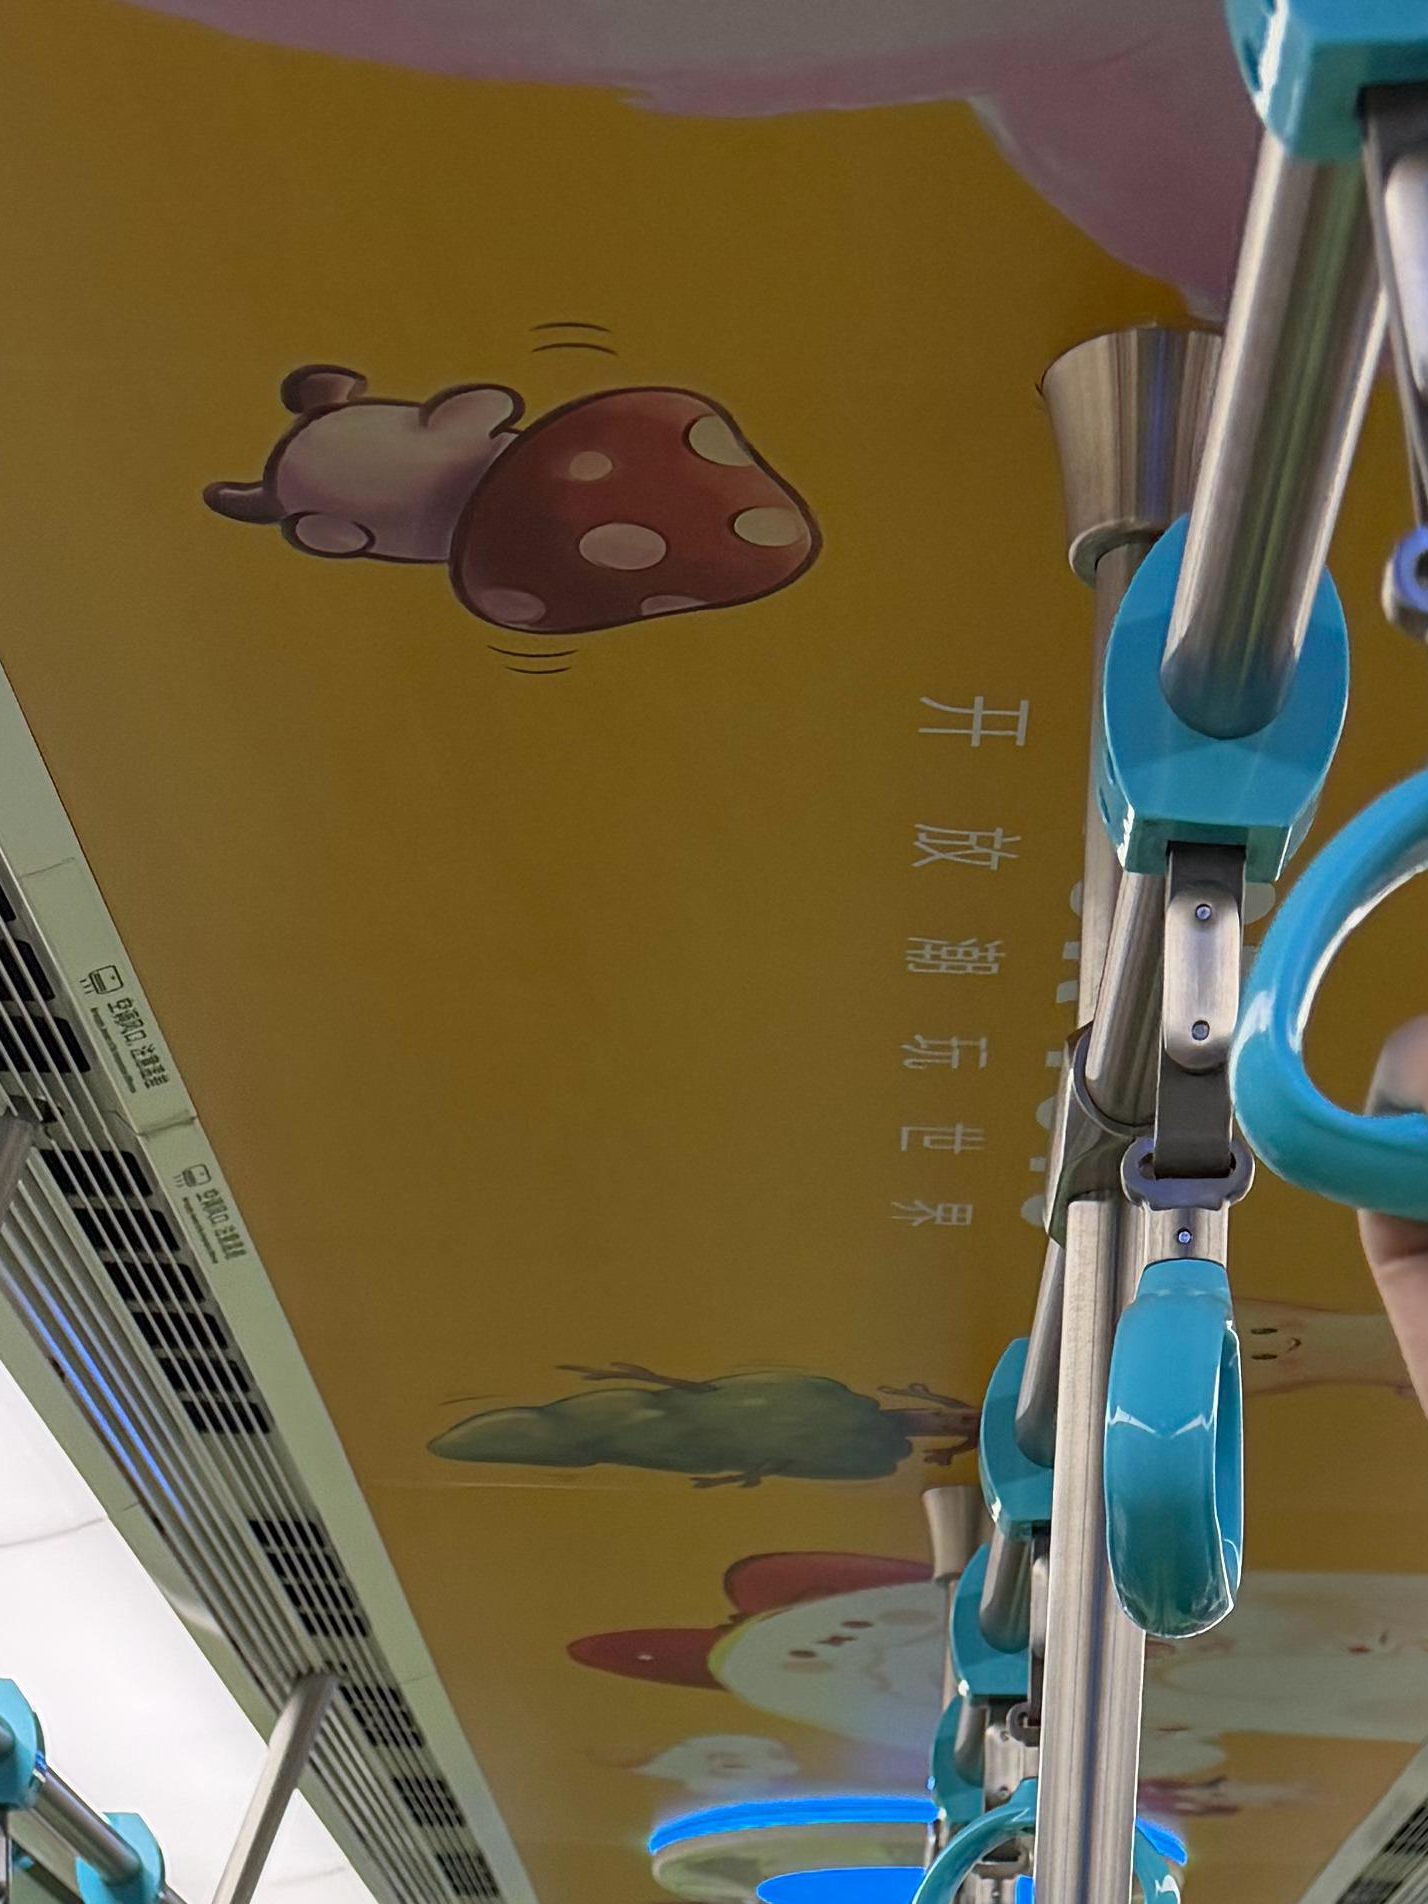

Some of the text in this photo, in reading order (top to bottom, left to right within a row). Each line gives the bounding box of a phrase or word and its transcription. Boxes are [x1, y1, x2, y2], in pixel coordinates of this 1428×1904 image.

[891, 696, 1030, 1227] 开放潮玩世界
